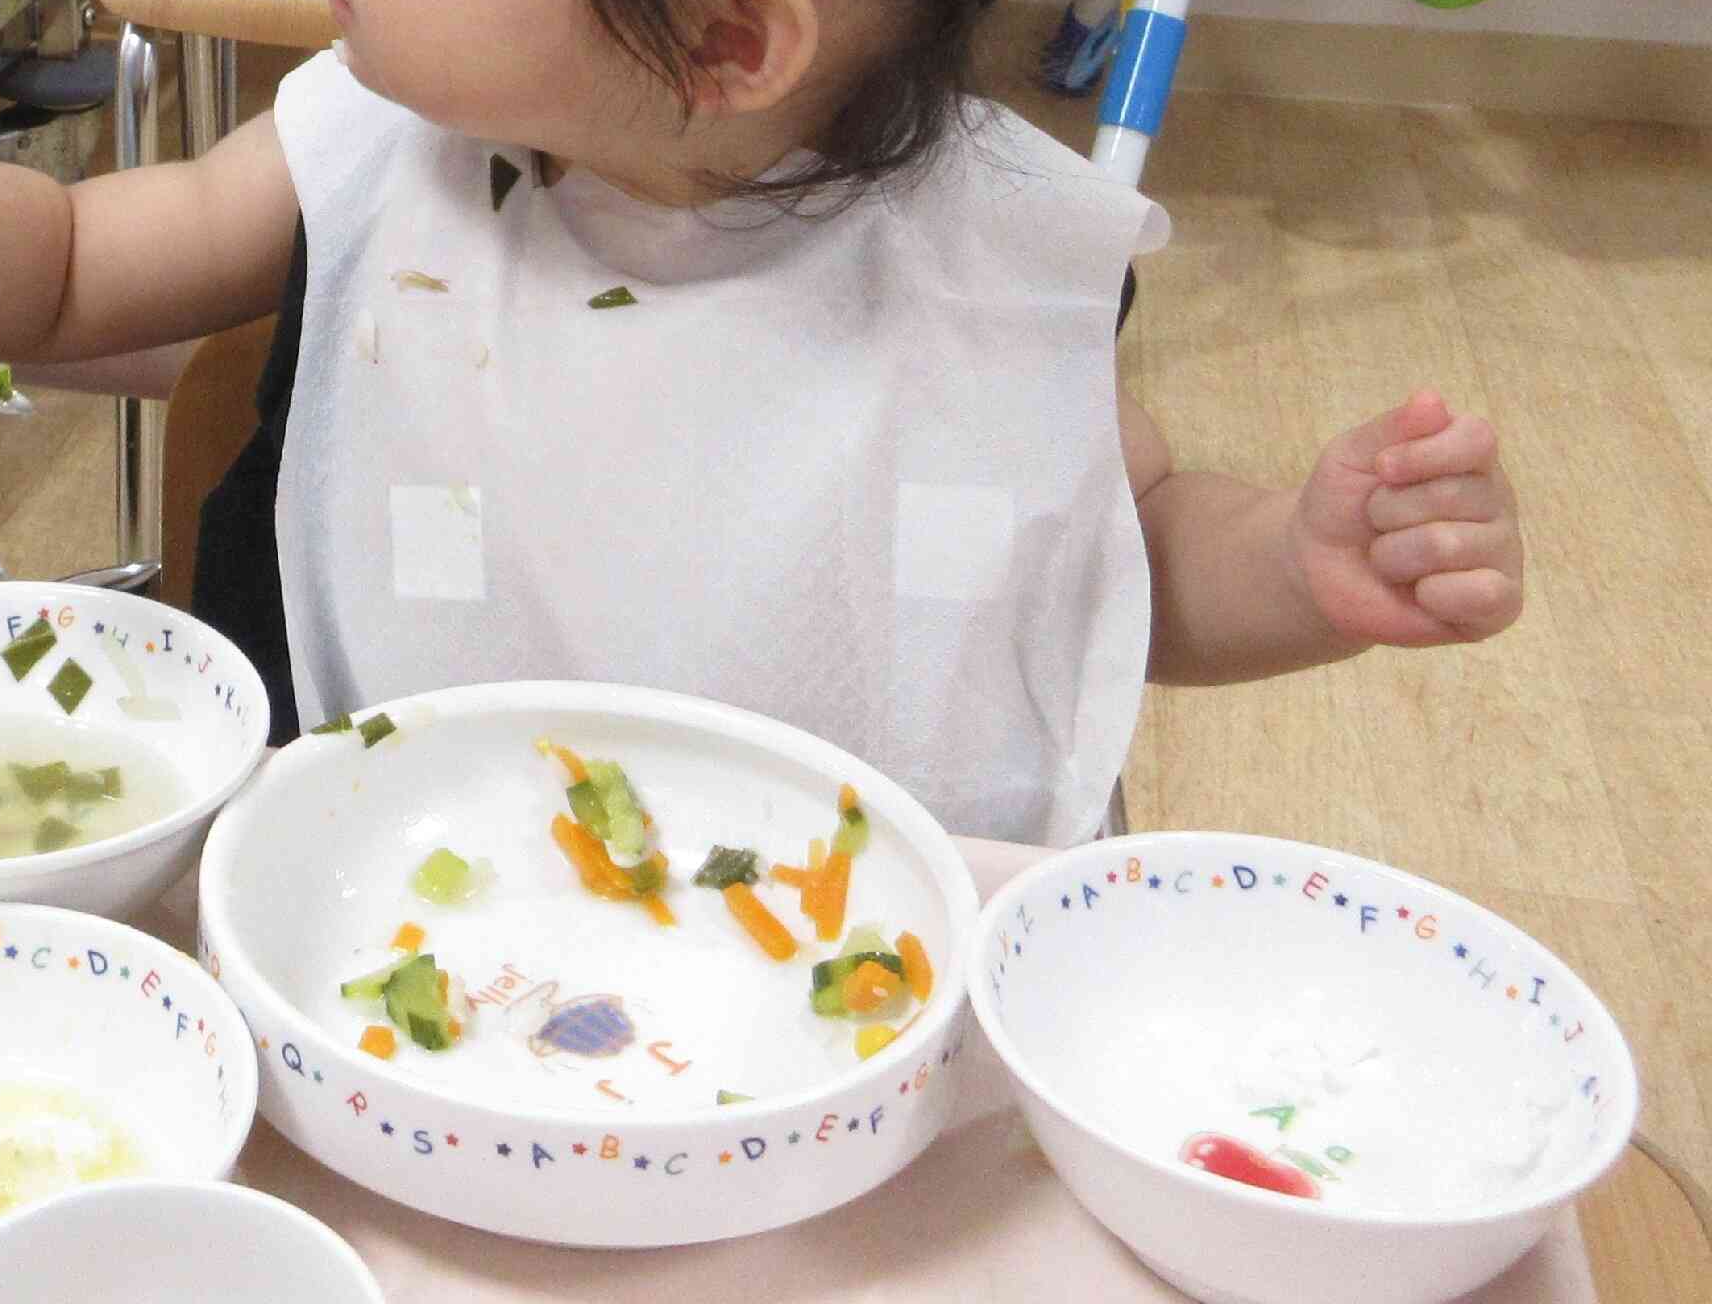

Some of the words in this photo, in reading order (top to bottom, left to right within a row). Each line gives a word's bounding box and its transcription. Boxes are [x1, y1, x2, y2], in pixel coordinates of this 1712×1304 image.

[58, 607, 75, 628] G
[163, 630, 172, 651] I
[198, 654, 212, 673] J
[1083, 884, 1099, 908] A
[1127, 858, 1141, 882] B
[1174, 871, 1192, 894] C
[1233, 866, 1257, 889] D
[1303, 872, 1328, 900] E
[1360, 906, 1378, 932] F
[1415, 915, 1436, 939] G
[1469, 959, 1496, 989] H
[1529, 977, 1546, 1005] I
[32, 947, 51, 969] C
[88, 950, 108, 975] D
[141, 970, 160, 997] E
[176, 1012, 190, 1040] F
[282, 1043, 304, 1076] Q
[347, 1092, 367, 1116] R
[414, 1130, 432, 1154] S
[532, 1143, 554, 1168] A
[600, 1135, 619, 1160] B
[664, 1152, 688, 1176] C
[741, 1138, 766, 1160] D
[816, 1114, 838, 1142] E
[870, 1106, 882, 1134] F
